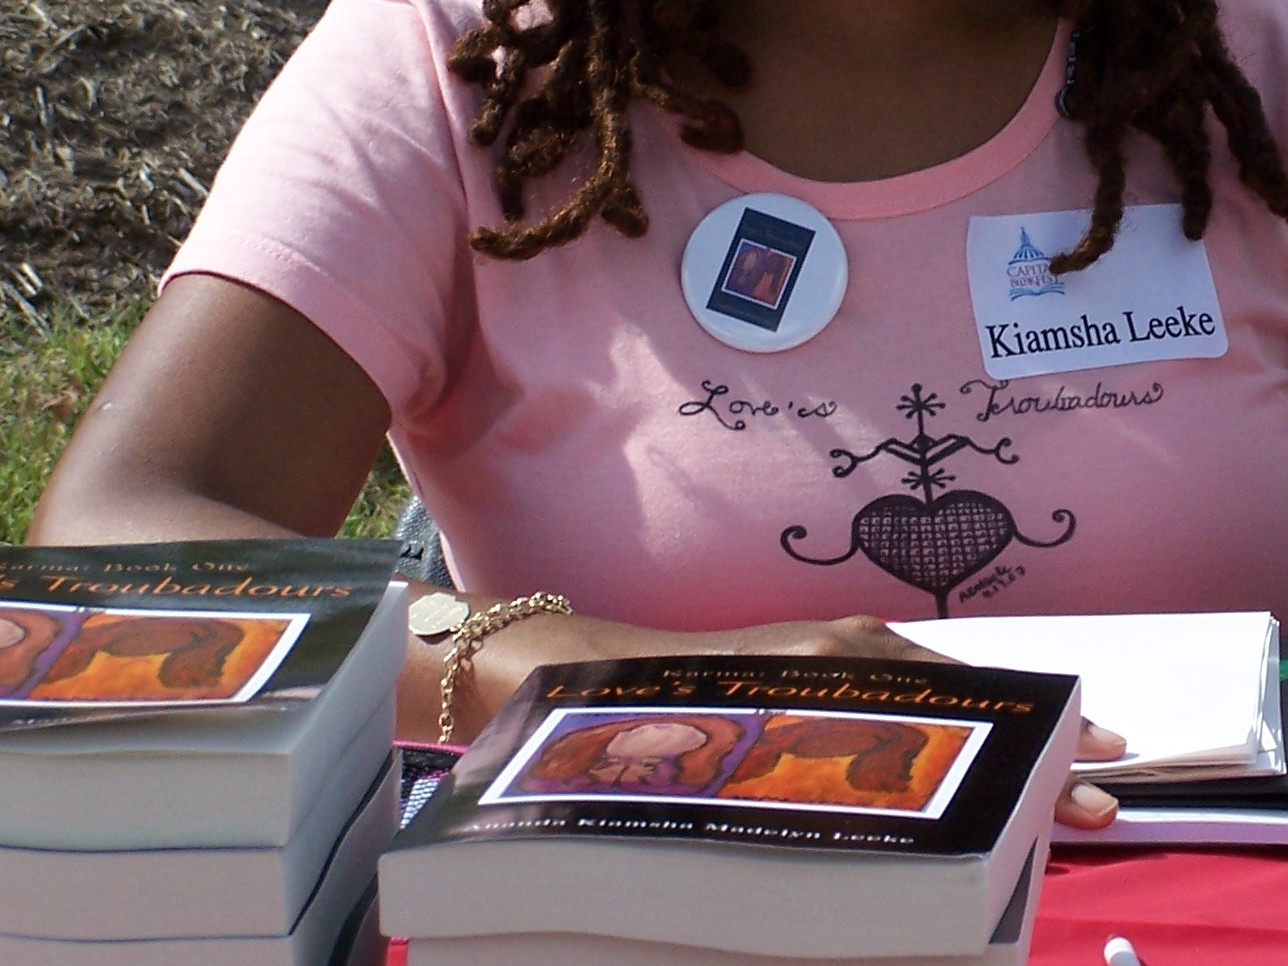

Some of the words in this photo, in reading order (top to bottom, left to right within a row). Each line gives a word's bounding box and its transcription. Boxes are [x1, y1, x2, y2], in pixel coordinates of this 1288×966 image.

[985, 314, 1121, 359] Kiamsha
[1122, 305, 1216, 343] Leeke
[41, 574, 351, 599] Troubadours
[545, 680, 698, 699] Love's
[716, 681, 1036, 714] Troubadours
